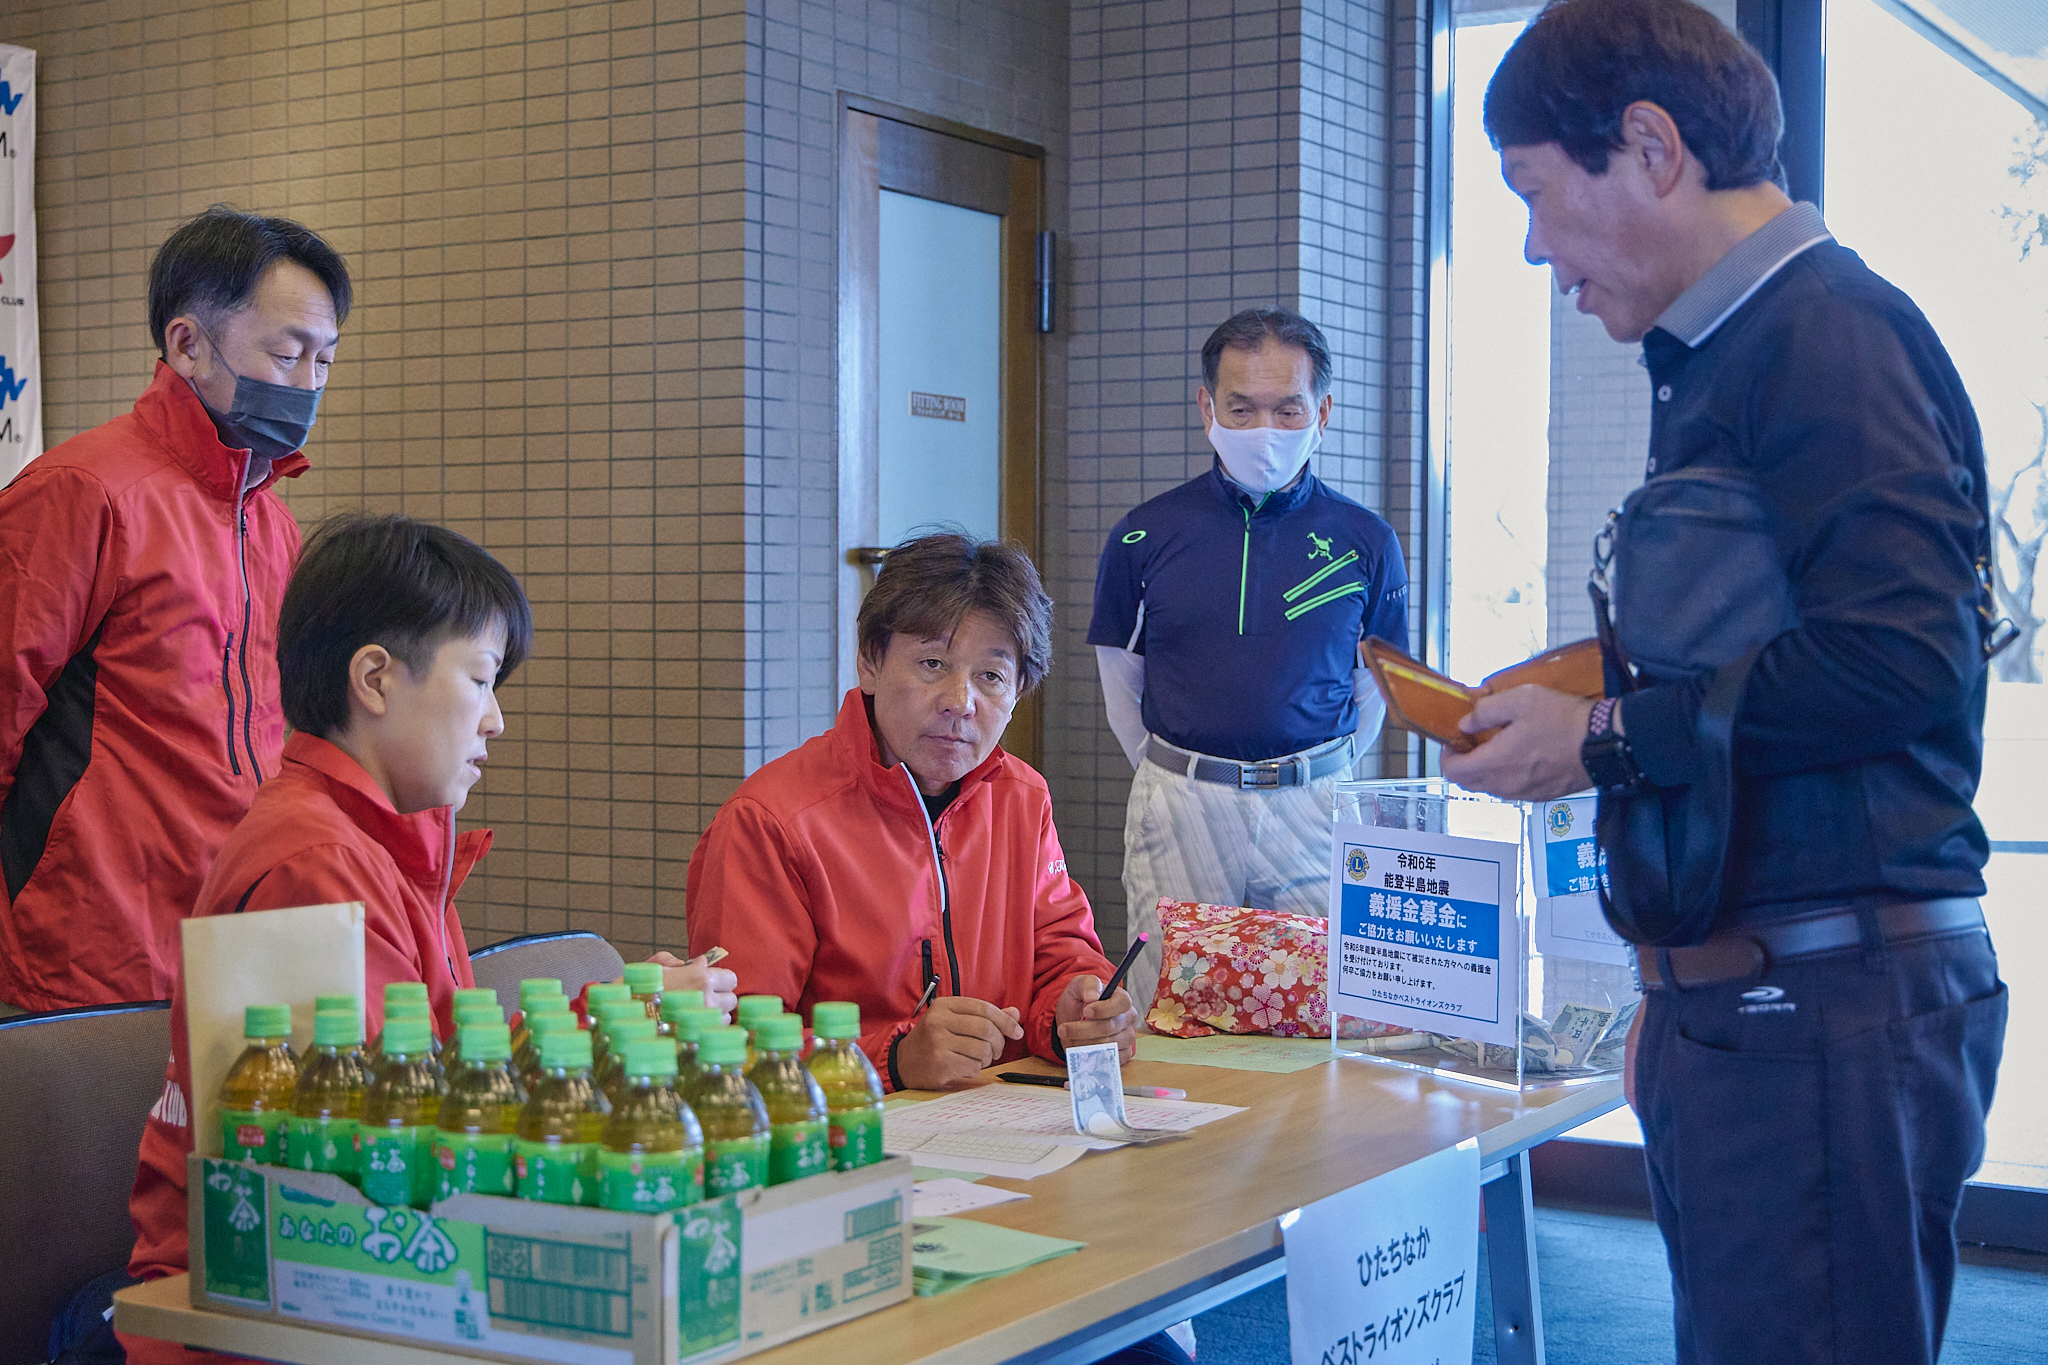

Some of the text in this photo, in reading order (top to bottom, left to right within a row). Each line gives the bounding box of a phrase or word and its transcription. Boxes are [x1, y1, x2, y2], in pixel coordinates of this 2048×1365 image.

[1397, 852, 1437, 872] 令和6年
[1384, 872, 1450, 896] 能登半島地震
[1369, 892, 1467, 929] 義援金募金に
[1358, 922, 1478, 953] ご協力をお願いいたします
[1343, 941, 1492, 975] 令和6年能登半島地震にて被災された方々への義援金
[1343, 954, 1404, 973] を受け付けております。
[1342, 965, 1436, 990] 何卒ご協力をお願い申し上げます。
[1372, 989, 1463, 1012] ひたちなかベストライオンズクラブ
[1357, 1225, 1430, 1286] ひたちなか
